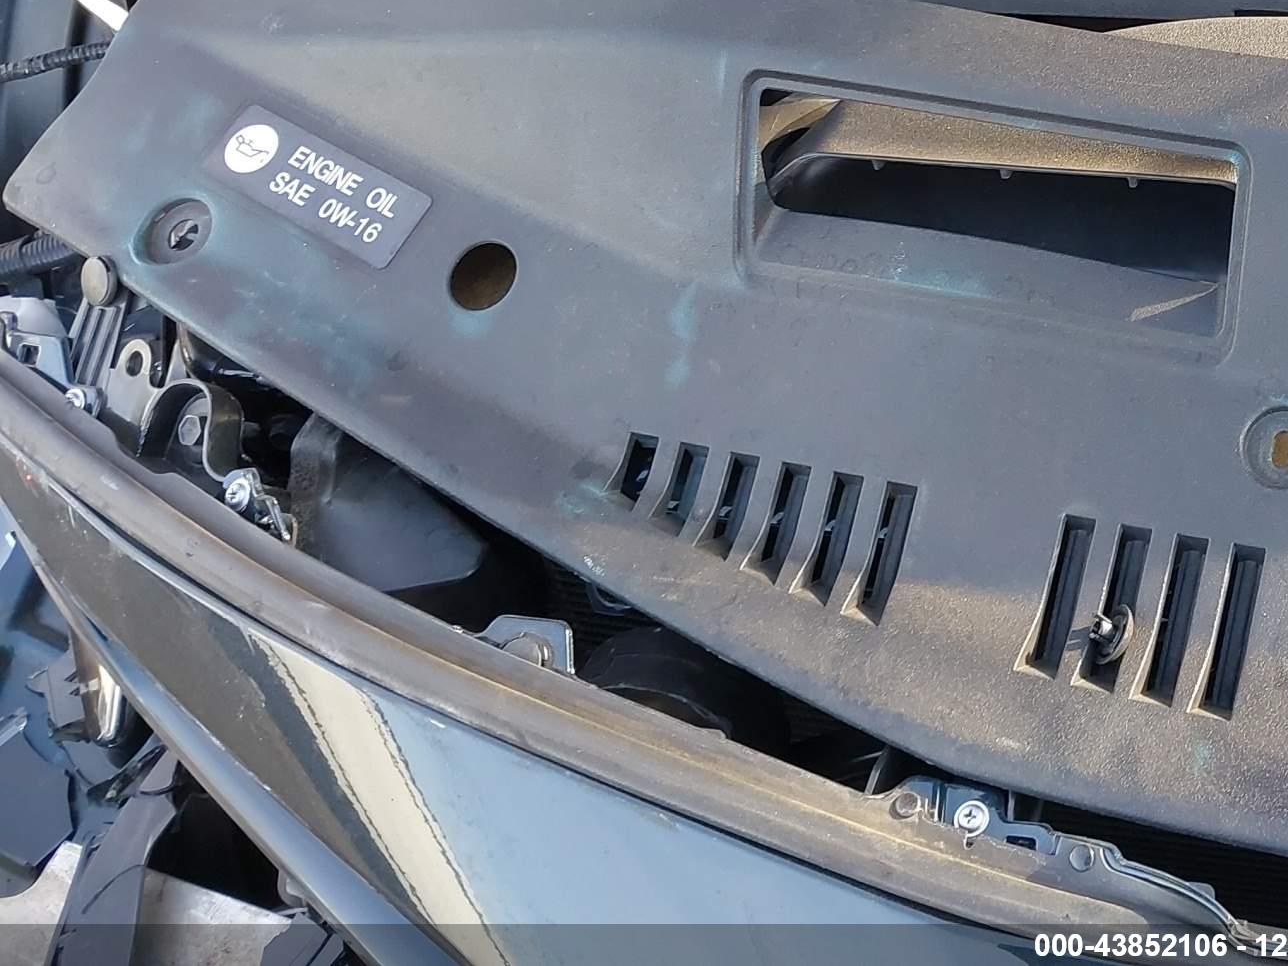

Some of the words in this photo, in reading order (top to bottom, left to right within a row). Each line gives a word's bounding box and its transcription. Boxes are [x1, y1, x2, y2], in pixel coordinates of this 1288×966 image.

[269, 172, 316, 207] SAE
[318, 198, 382, 242] 0W-16
[287, 146, 364, 196] ENGINE
[366, 187, 398, 218] OIL
